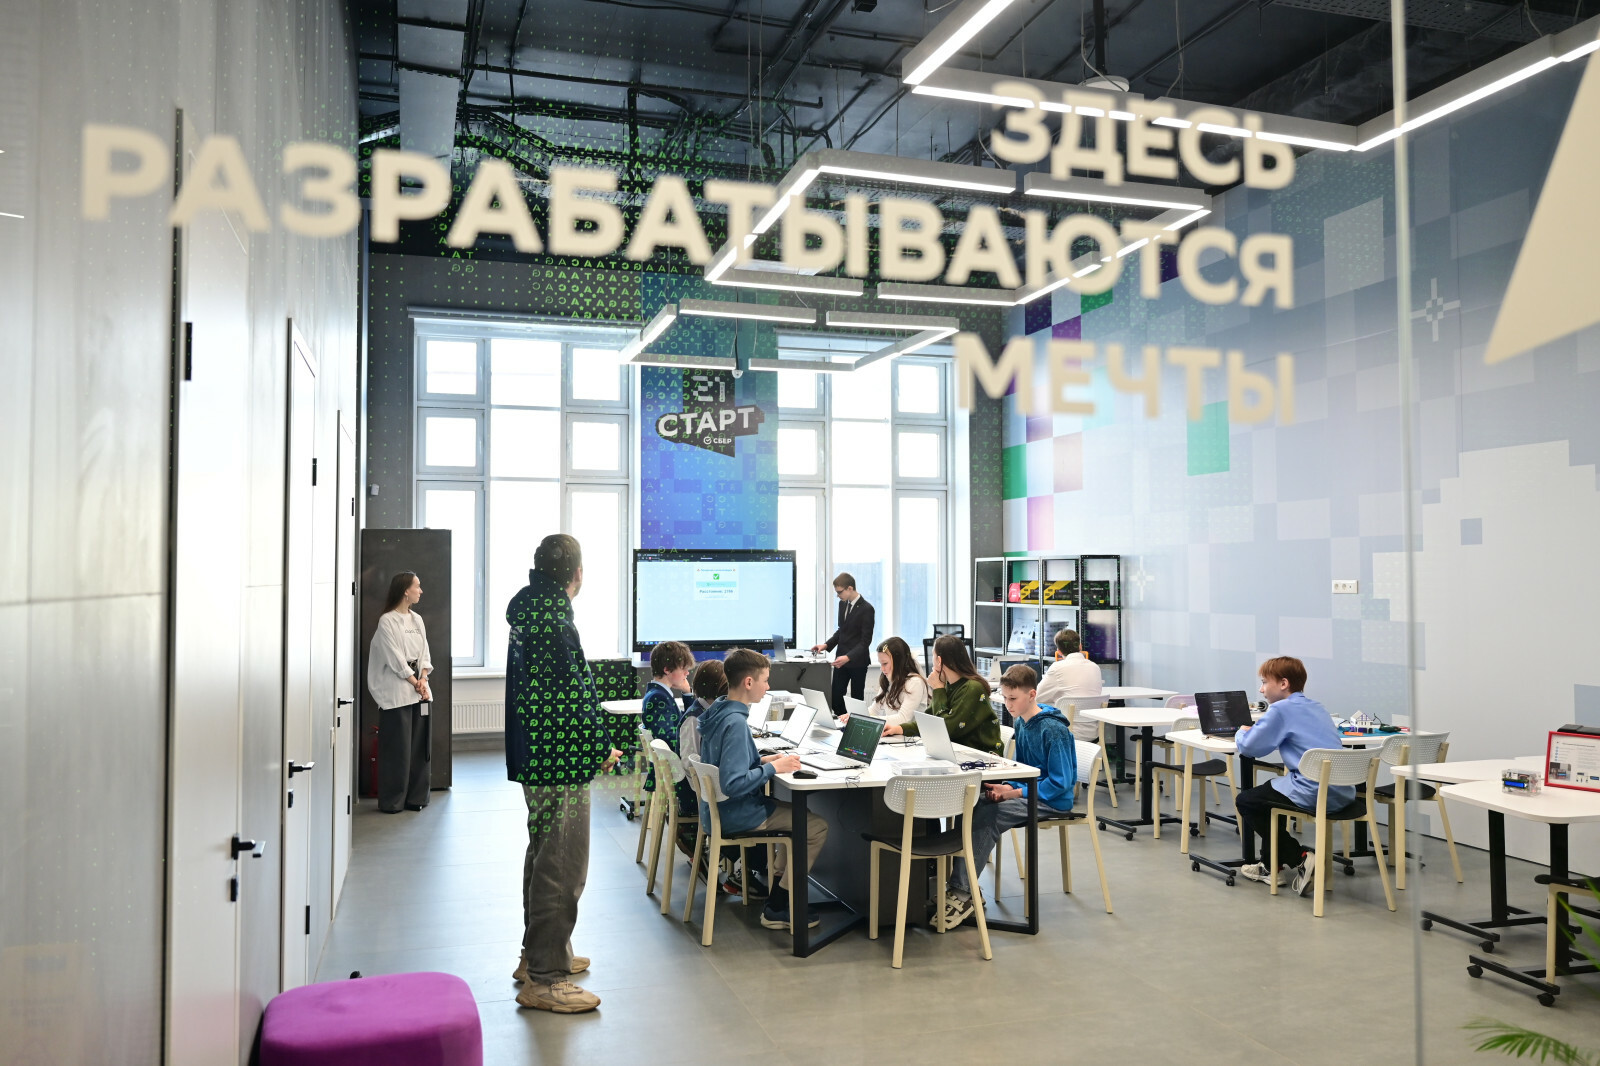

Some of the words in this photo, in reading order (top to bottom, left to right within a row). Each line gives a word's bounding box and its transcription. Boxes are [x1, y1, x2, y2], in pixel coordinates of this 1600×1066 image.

[990, 81, 1295, 190] ЗДЕСЬ
[80, 122, 1295, 310] РАЗРАБАТЫВАЮТСЯ
[658, 407, 755, 437] СТАРТ
[954, 332, 1295, 425] МЕЧТЫ
